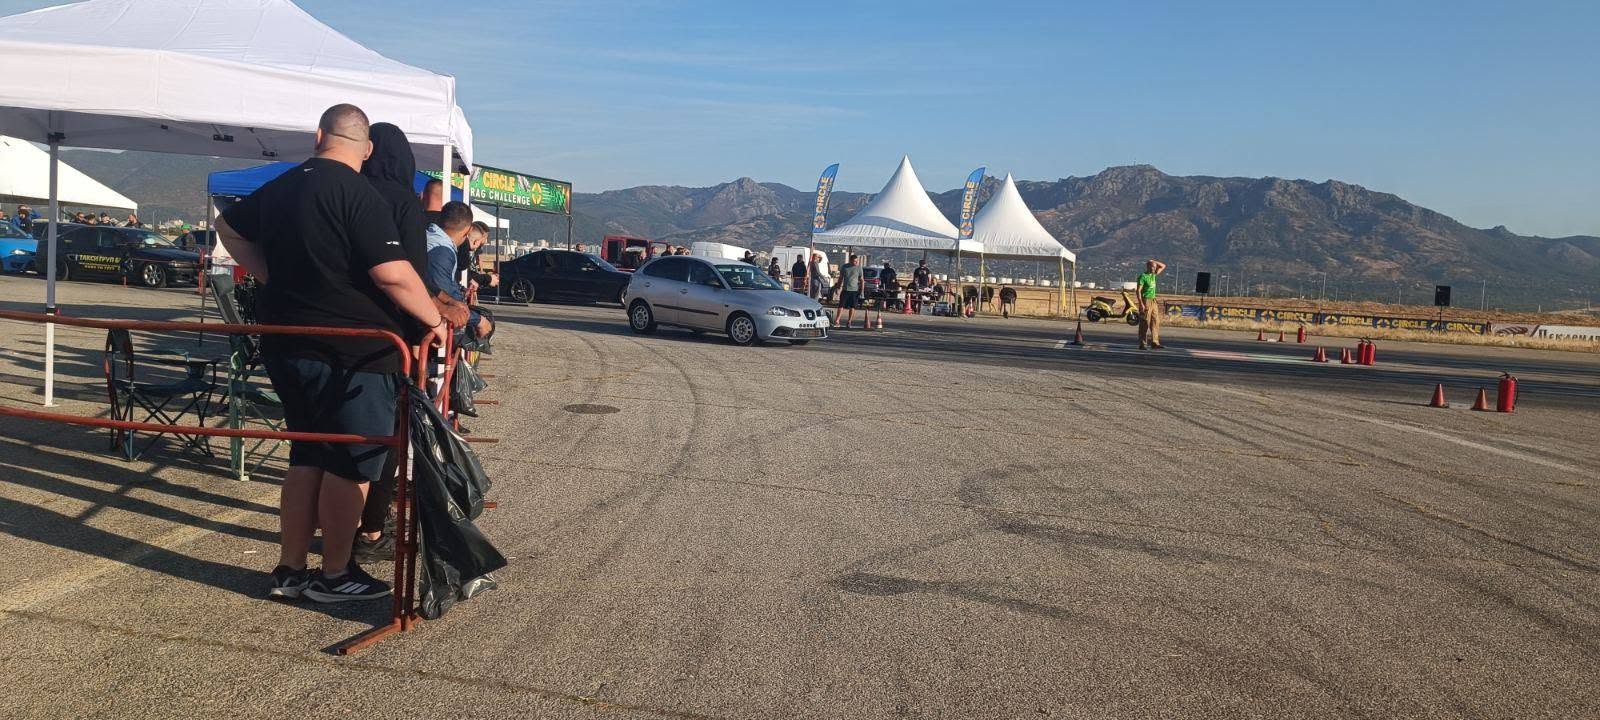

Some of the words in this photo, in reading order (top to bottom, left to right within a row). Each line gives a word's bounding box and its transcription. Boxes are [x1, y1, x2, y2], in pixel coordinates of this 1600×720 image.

[483, 171, 515, 192] CIRCLE
[470, 188, 486, 199] RAG
[488, 189, 531, 206] CHALLENGE
[816, 176, 829, 214] CIRCLE
[962, 181, 975, 220] CIRCLE
[1221, 307, 1256, 318] CIRCLE
[1277, 311, 1313, 322] CIRCLE
[1339, 316, 1373, 326] CIRCLE
[1392, 319, 1428, 329] CIRCLE
